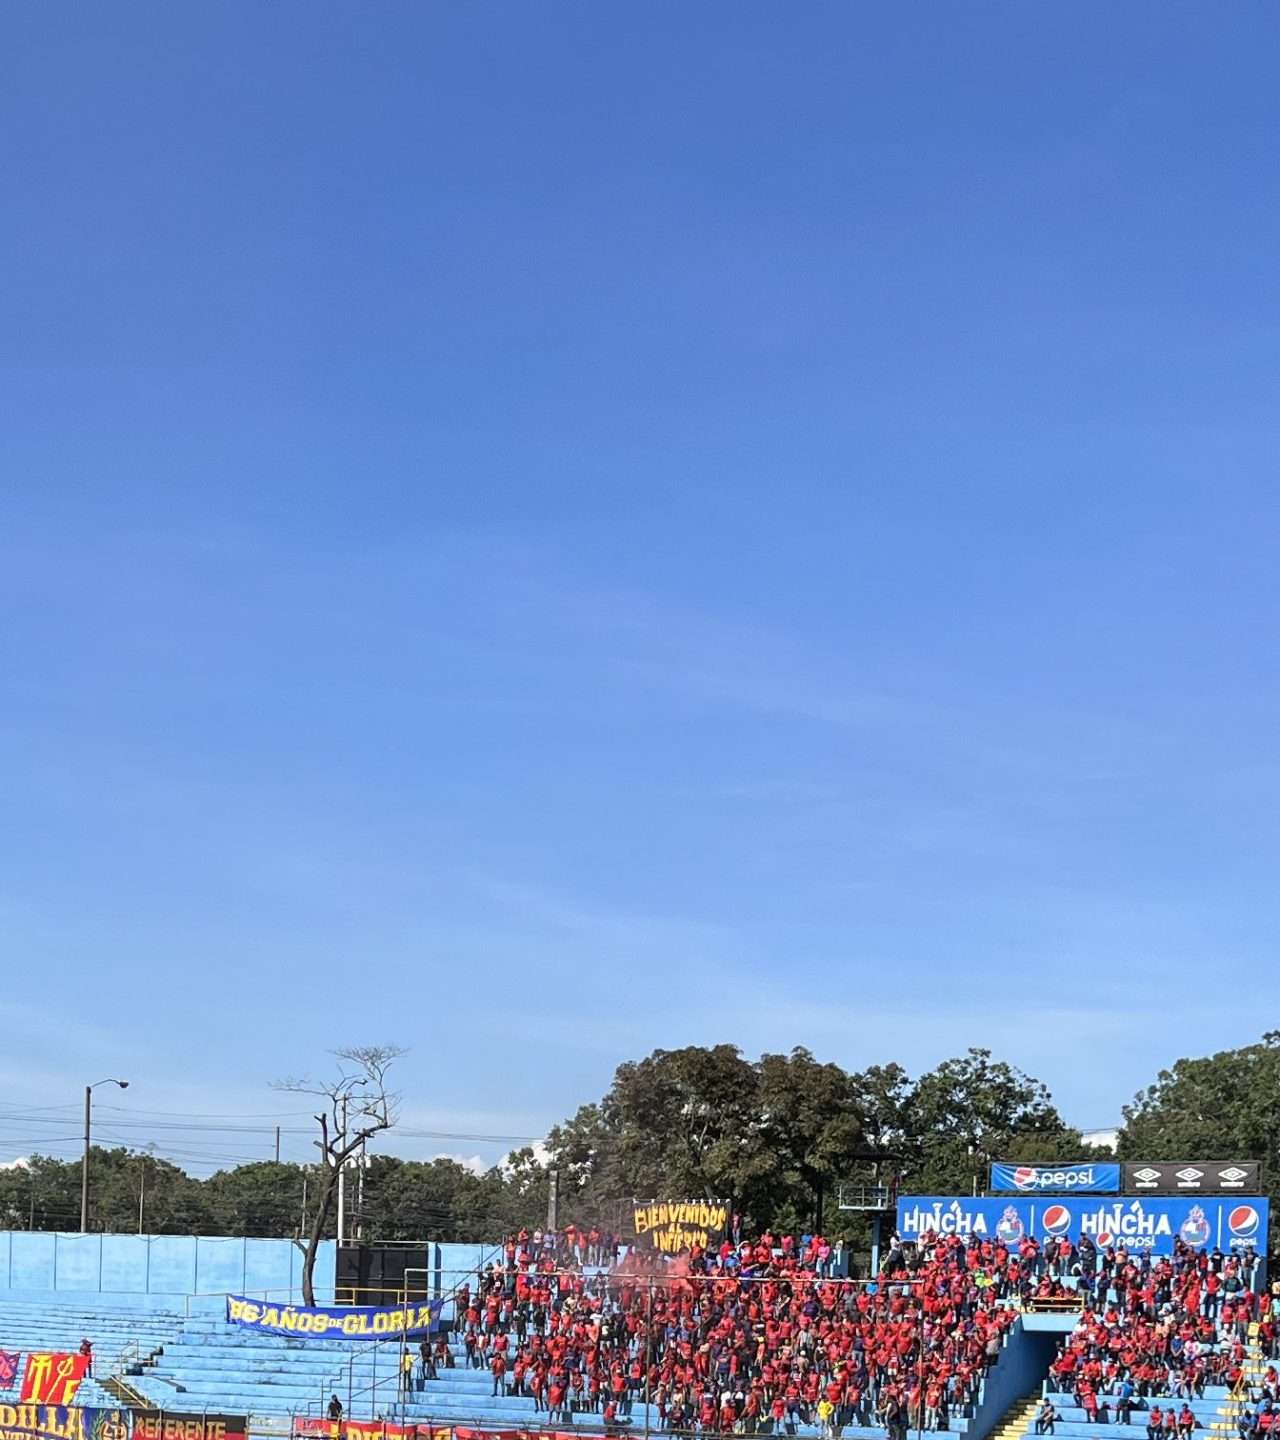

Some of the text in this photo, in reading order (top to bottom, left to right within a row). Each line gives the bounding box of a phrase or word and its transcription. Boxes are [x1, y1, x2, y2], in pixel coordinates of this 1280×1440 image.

[1040, 1168, 1094, 1187] pepsi
[634, 1203, 726, 1234] BIENVENIDOS
[904, 1202, 987, 1233] HINCHA
[1081, 1202, 1171, 1235] HINCHA
[1116, 1234, 1155, 1248] pepsi
[262, 1305, 329, 1333] AÑOS
[342, 1305, 433, 1335] GLORIA
